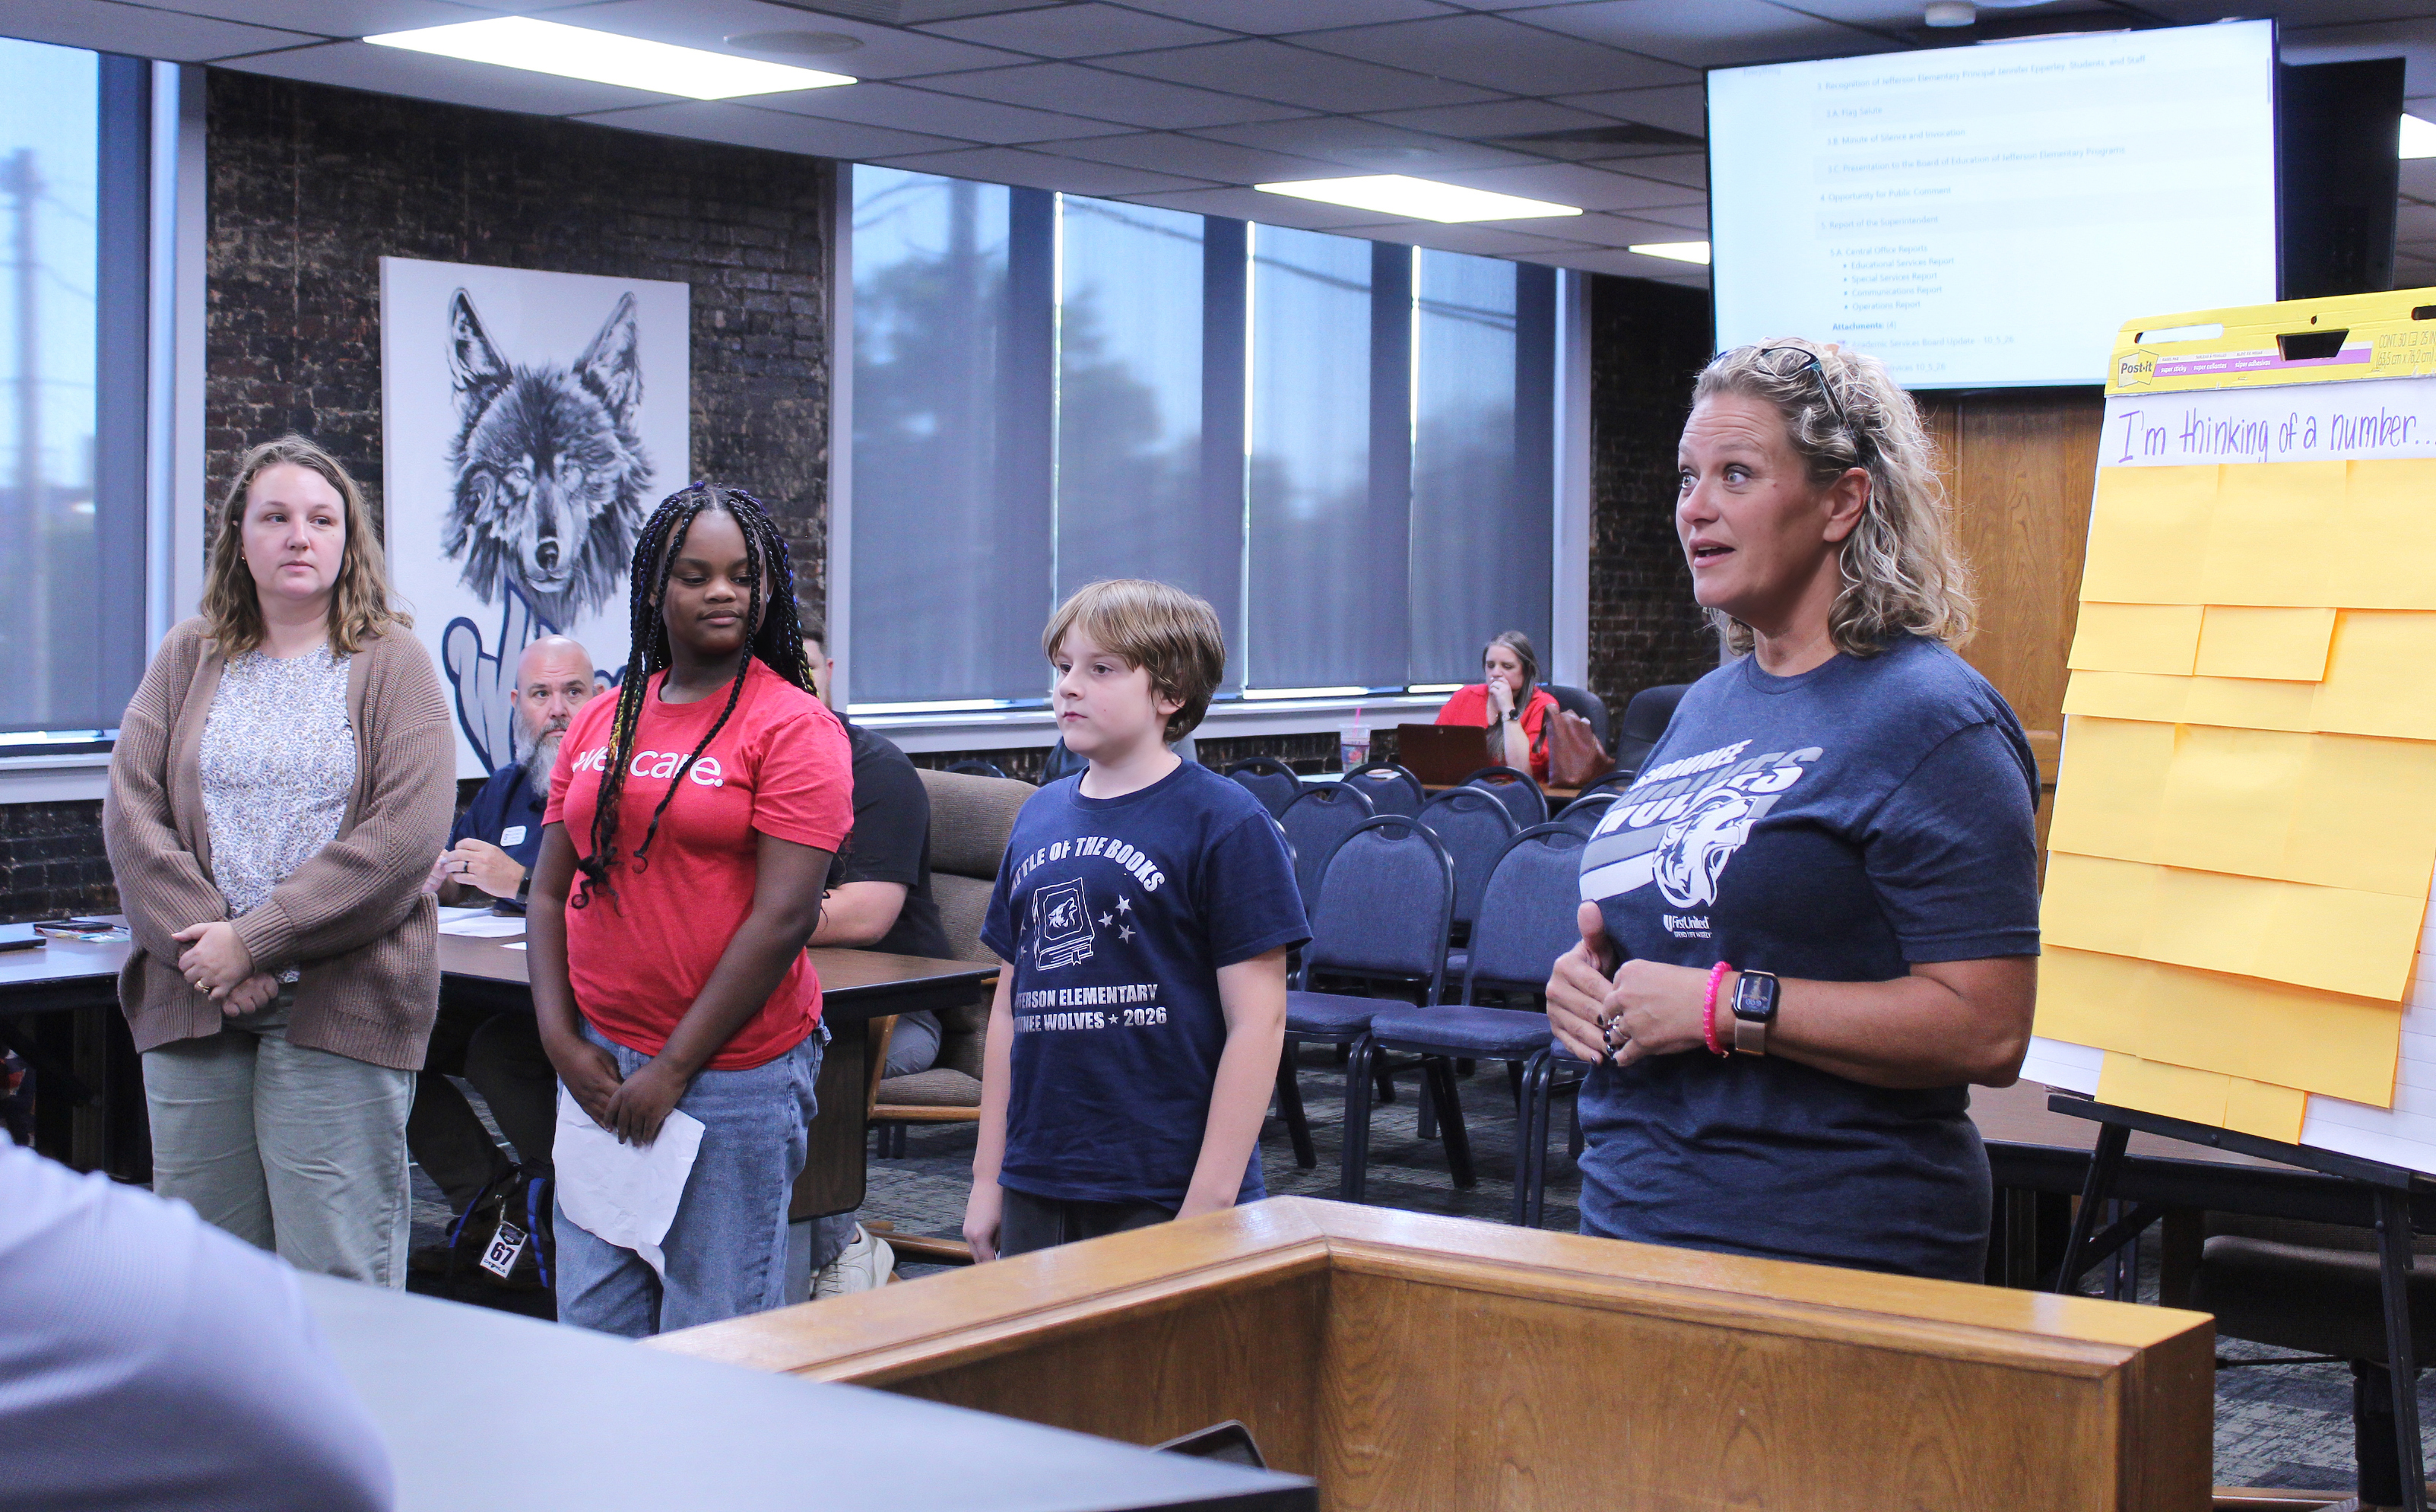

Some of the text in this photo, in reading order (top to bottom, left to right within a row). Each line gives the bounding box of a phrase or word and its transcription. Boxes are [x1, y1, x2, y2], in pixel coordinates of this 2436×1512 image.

[1825, 79, 1870, 91] Recognition
[1872, 78, 1880, 87] of
[1882, 76, 1915, 85] Jefferson
[1917, 72, 1960, 82] Elementary
[1962, 68, 1996, 78] Principal
[2109, 56, 2124, 65] and
[2127, 54, 2146, 63] Staff
[1842, 108, 1857, 118] Flag
[1860, 106, 1883, 115] Salute
[1842, 135, 1868, 144] Minute
[1870, 133, 1878, 142] of
[1880, 132, 1907, 142] Silence
[1909, 129, 1924, 139] and
[1926, 128, 1965, 138] Invocation
[1843, 161, 1889, 173] Presentation
[1902, 160, 1914, 168] the
[1917, 158, 1939, 167] Board
[1942, 157, 1949, 166] of
[1951, 155, 1989, 165] Education
[1992, 154, 2000, 162] of
[2003, 152, 2037, 161] Jefferson
[2039, 149, 2083, 160] Elementary
[2086, 146, 2125, 157] Programs
[1829, 191, 1873, 203] Opportunity
[1889, 189, 1911, 198] Public
[1914, 186, 1951, 196] Comment
[1829, 220, 1854, 230] Report
[1857, 219, 1863, 227] of
[1867, 218, 1878, 227] the
[1880, 216, 1938, 228] Superintendent
[1846, 247, 1872, 256] Central
[1874, 246, 1896, 255] Office
[1898, 244, 1928, 255] Reports
[1851, 256, 1954, 269] Educational Services Report
[1851, 271, 1937, 284] Special Services Report
[1852, 285, 1943, 297] Communications Report
[1852, 300, 1921, 312] Operations Report
[1886, 320, 1896, 330] (4)
[1890, 338, 1920, 347] Services
[1923, 336, 1945, 346] Board
[1947, 335, 1975, 347] Update
[2173, 364, 2187, 373] sticky
[2118, 410, 2166, 463] I'm
[2179, 407, 2269, 463] thinking
[2279, 411, 2298, 453] of
[2303, 415, 2317, 449] a
[1049, 840, 1071, 861] OF
[1074, 836, 1109, 857] THE
[1103, 838, 1166, 892] BOOKS
[1059, 984, 1159, 1006] ELEMENTARY
[1044, 1011, 1105, 1032] WOLVES
[1123, 1006, 1168, 1027] 2026
[490, 1241, 515, 1266] 67
